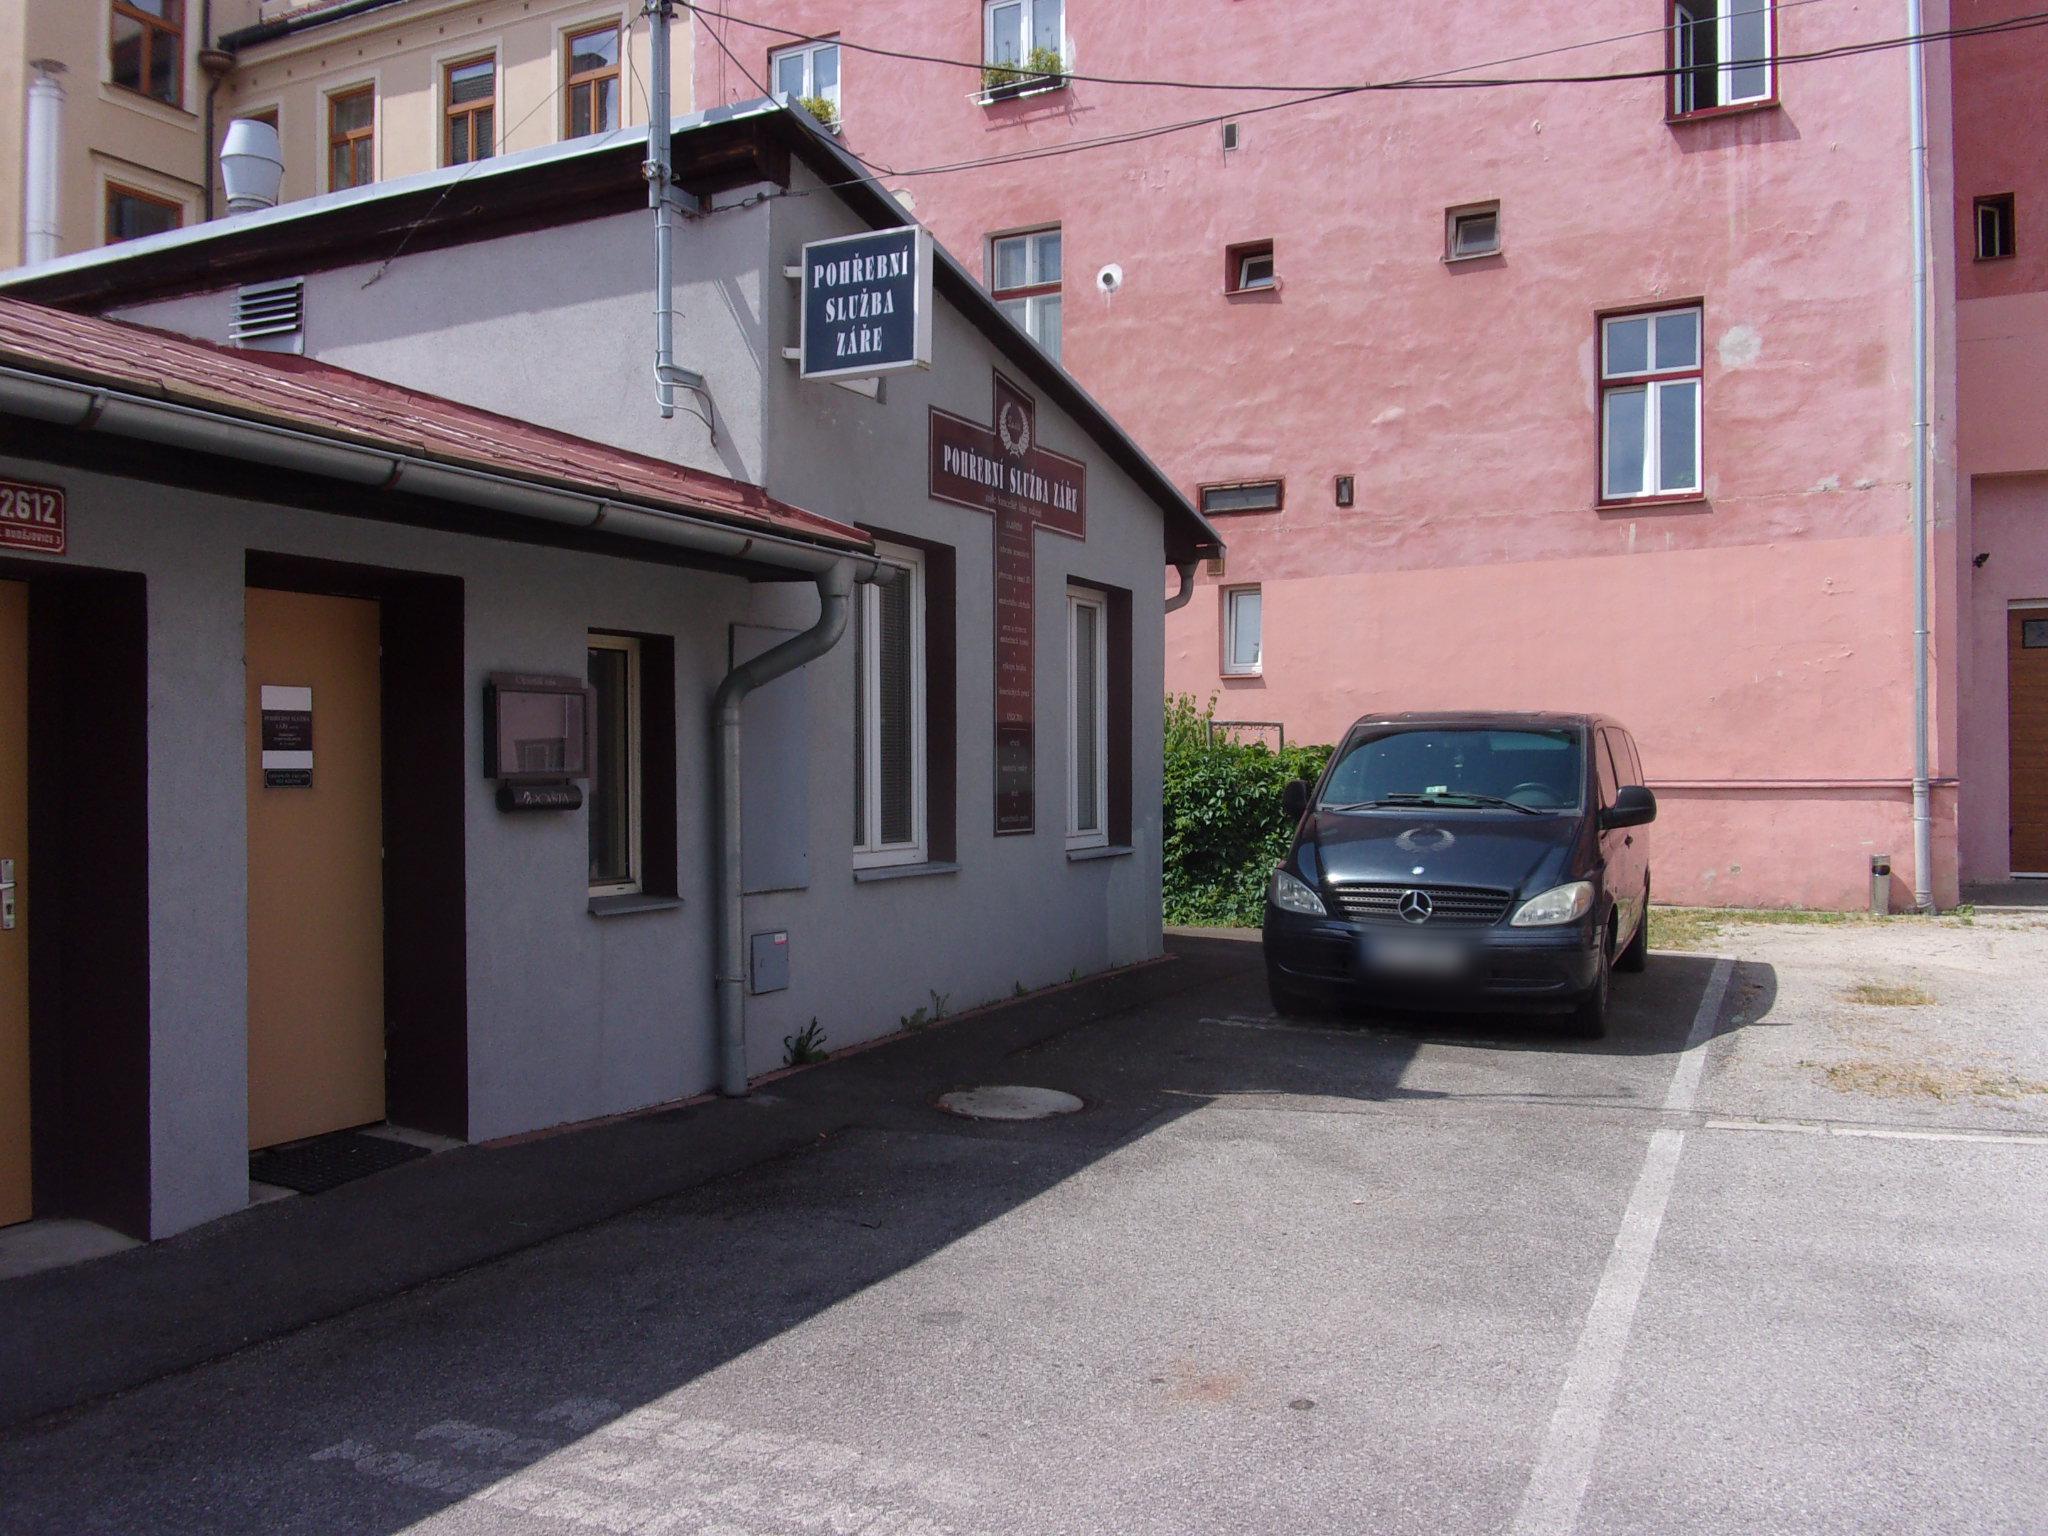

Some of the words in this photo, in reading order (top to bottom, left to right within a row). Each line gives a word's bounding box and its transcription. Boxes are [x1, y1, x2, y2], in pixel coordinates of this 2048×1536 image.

[813, 245, 908, 288] POHŘEBNÍ
[825, 288, 894, 323] SLUŽBA
[836, 324, 882, 357] ZÁŘE
[943, 445, 1004, 490] POHŘEBNÍ
[1009, 467, 1049, 504] SLUŽBA
[1053, 479, 1078, 513] ZÁŘE
[0, 488, 56, 524] 2612
